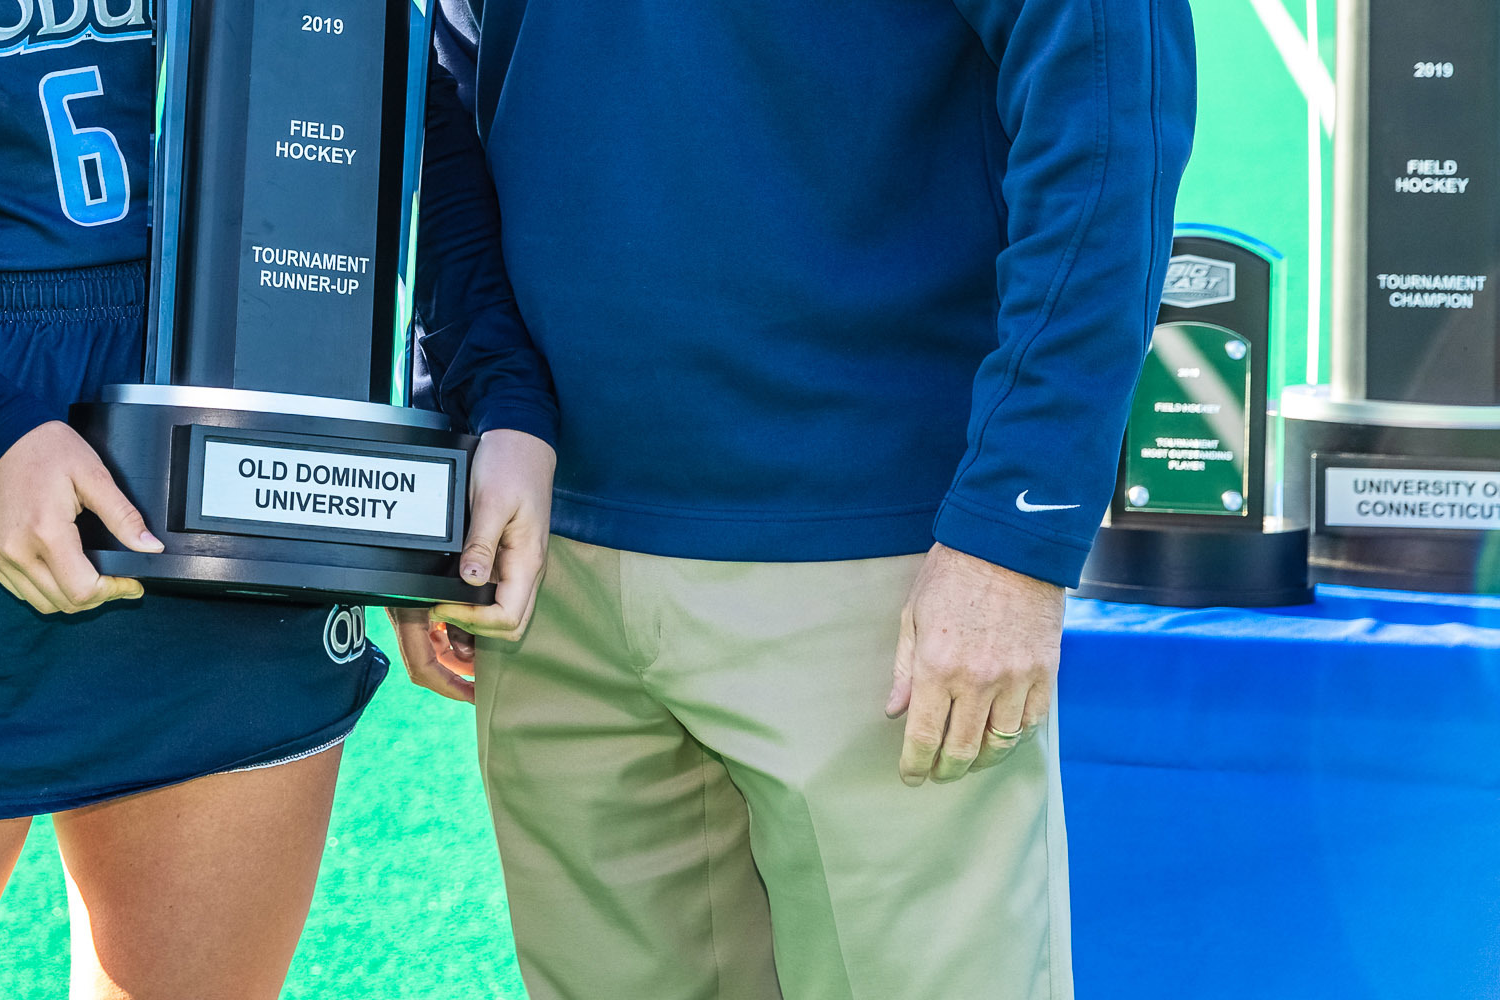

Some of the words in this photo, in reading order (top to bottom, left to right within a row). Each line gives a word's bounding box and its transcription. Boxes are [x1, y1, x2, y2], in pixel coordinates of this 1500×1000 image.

[301, 15, 344, 35] 2019
[1413, 62, 1455, 78] 2019
[290, 120, 345, 141] FIELD
[38, 65, 131, 227] 6
[275, 141, 357, 165] HOCKEY
[1407, 160, 1458, 175] FIELD
[1395, 177, 1470, 193] HOCKEY
[252, 246, 370, 274] TOURNAMENT
[260, 270, 359, 295] RUNNER-UP
[1377, 274, 1487, 291] TOURNAMENT
[1389, 292, 1474, 309] CHAMPION
[238, 458, 288, 481] OLD
[296, 463, 415, 492] DOMINION
[1353, 478, 1477, 497] UNIVERSITY
[255, 489, 398, 519] UNIVERSITY
